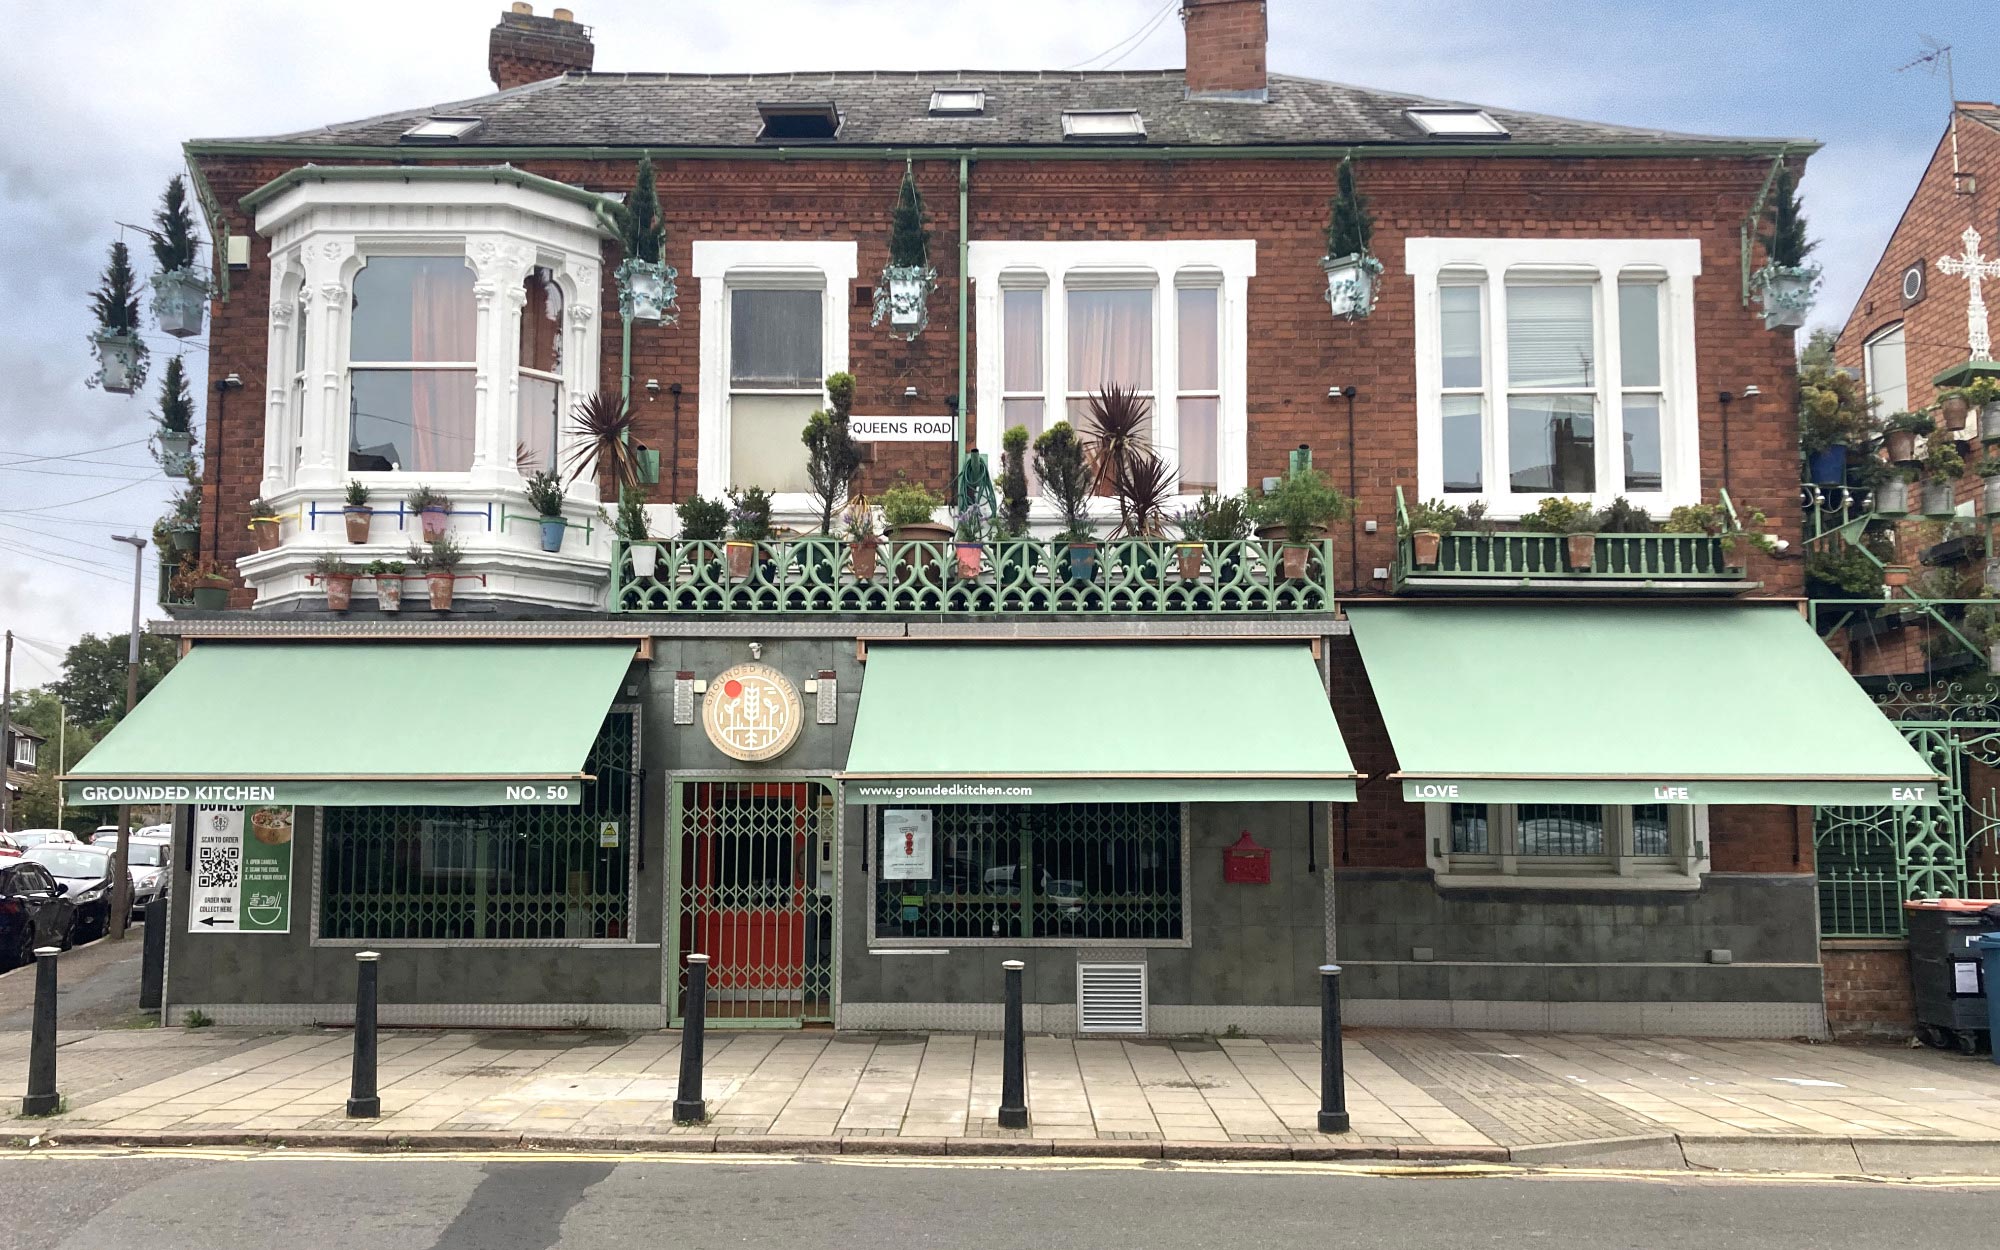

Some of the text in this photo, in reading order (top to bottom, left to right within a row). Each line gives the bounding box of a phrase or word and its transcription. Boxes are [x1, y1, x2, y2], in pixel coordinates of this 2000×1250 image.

[852, 422, 951, 435] QUEENS ROAD
[705, 665, 798, 706] GROUNDED KITCHEN
[82, 786, 275, 801] GROUNDED KITCHEN
[506, 785, 568, 800] NO. 50
[859, 784, 1032, 798] www.groundedkitchen.com
[1415, 784, 1459, 798] LOVE
[1891, 787, 1925, 801] EAT
